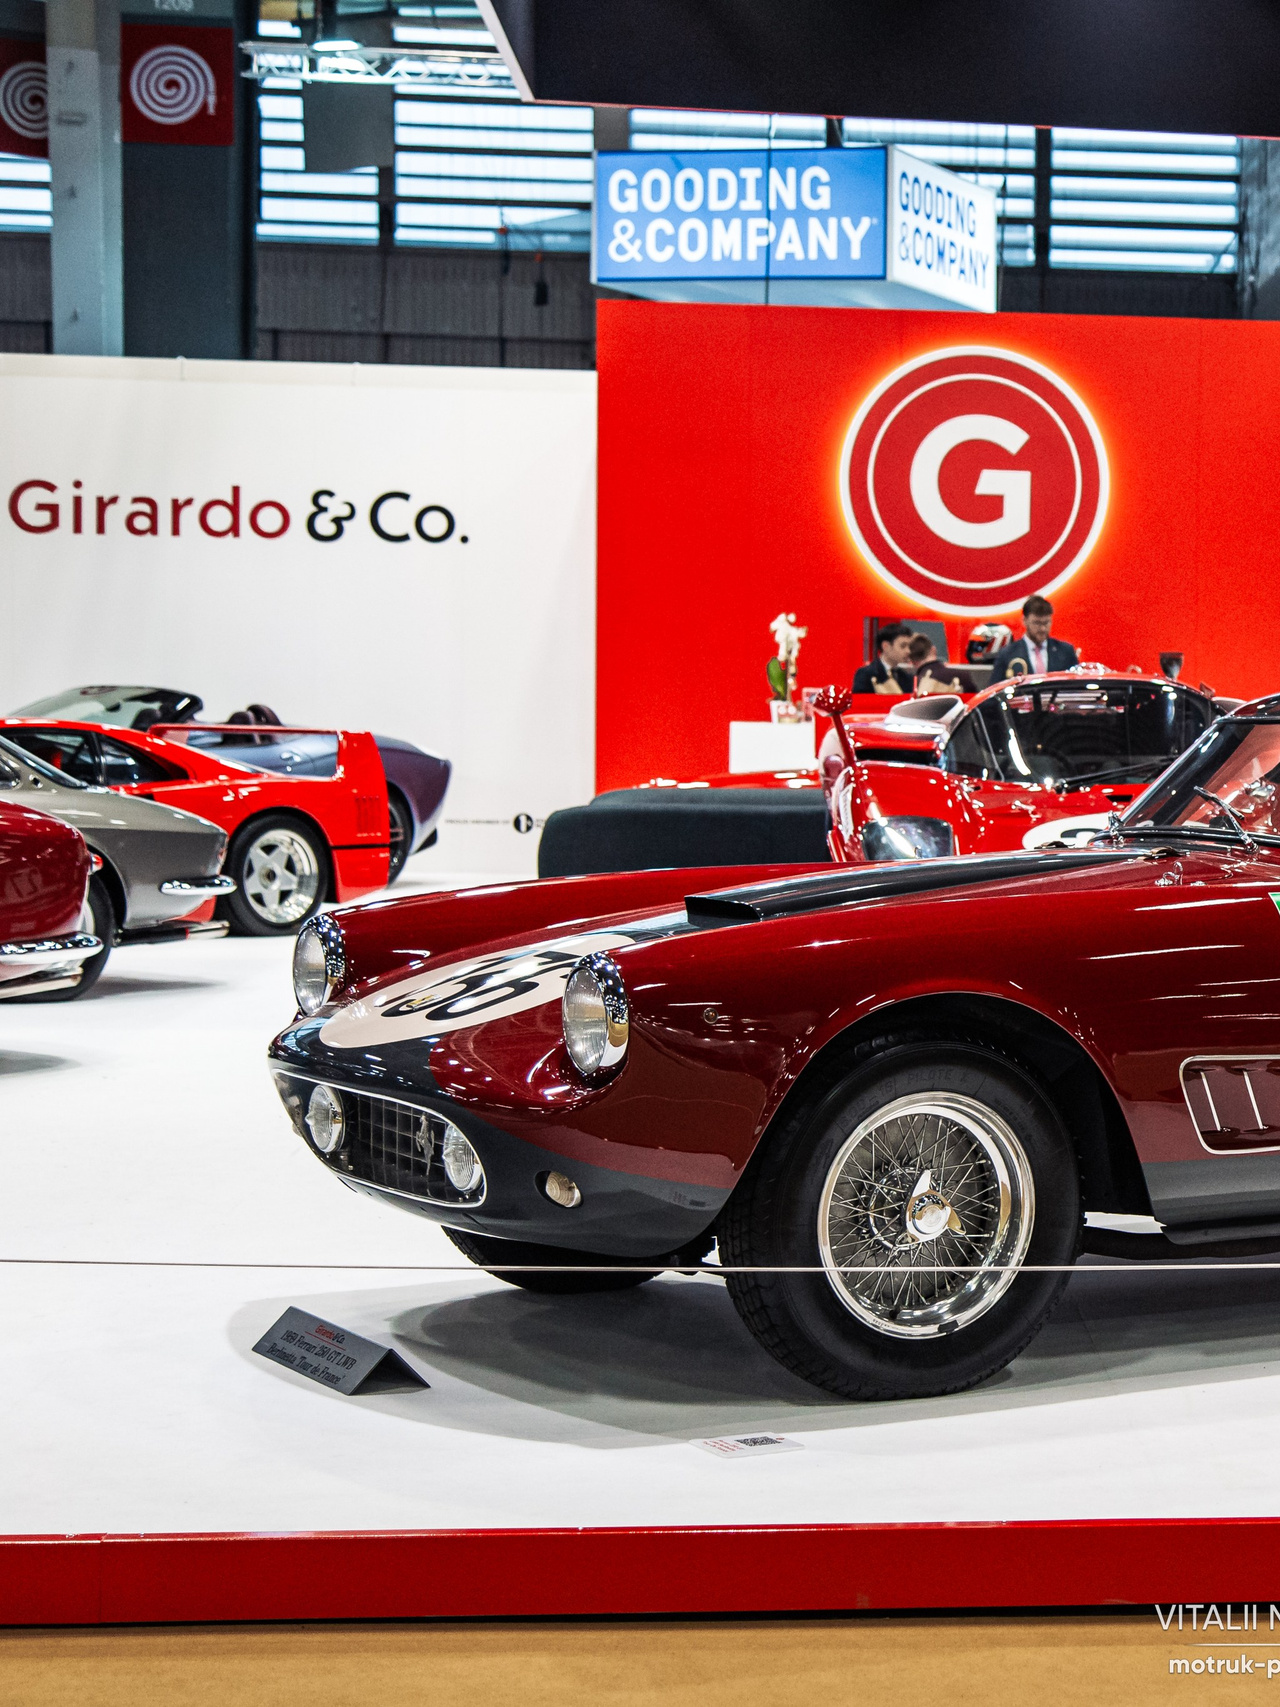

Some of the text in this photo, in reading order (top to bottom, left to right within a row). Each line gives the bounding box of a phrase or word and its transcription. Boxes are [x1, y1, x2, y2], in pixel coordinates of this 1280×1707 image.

[608, 167, 831, 213] GOODING
[900, 172, 976, 237] GOODING
[608, 217, 872, 263] &COMPANY
[900, 222, 989, 288] &COMPANY
[7, 479, 469, 545] Girardo & Co.
[909, 413, 1032, 549] G
